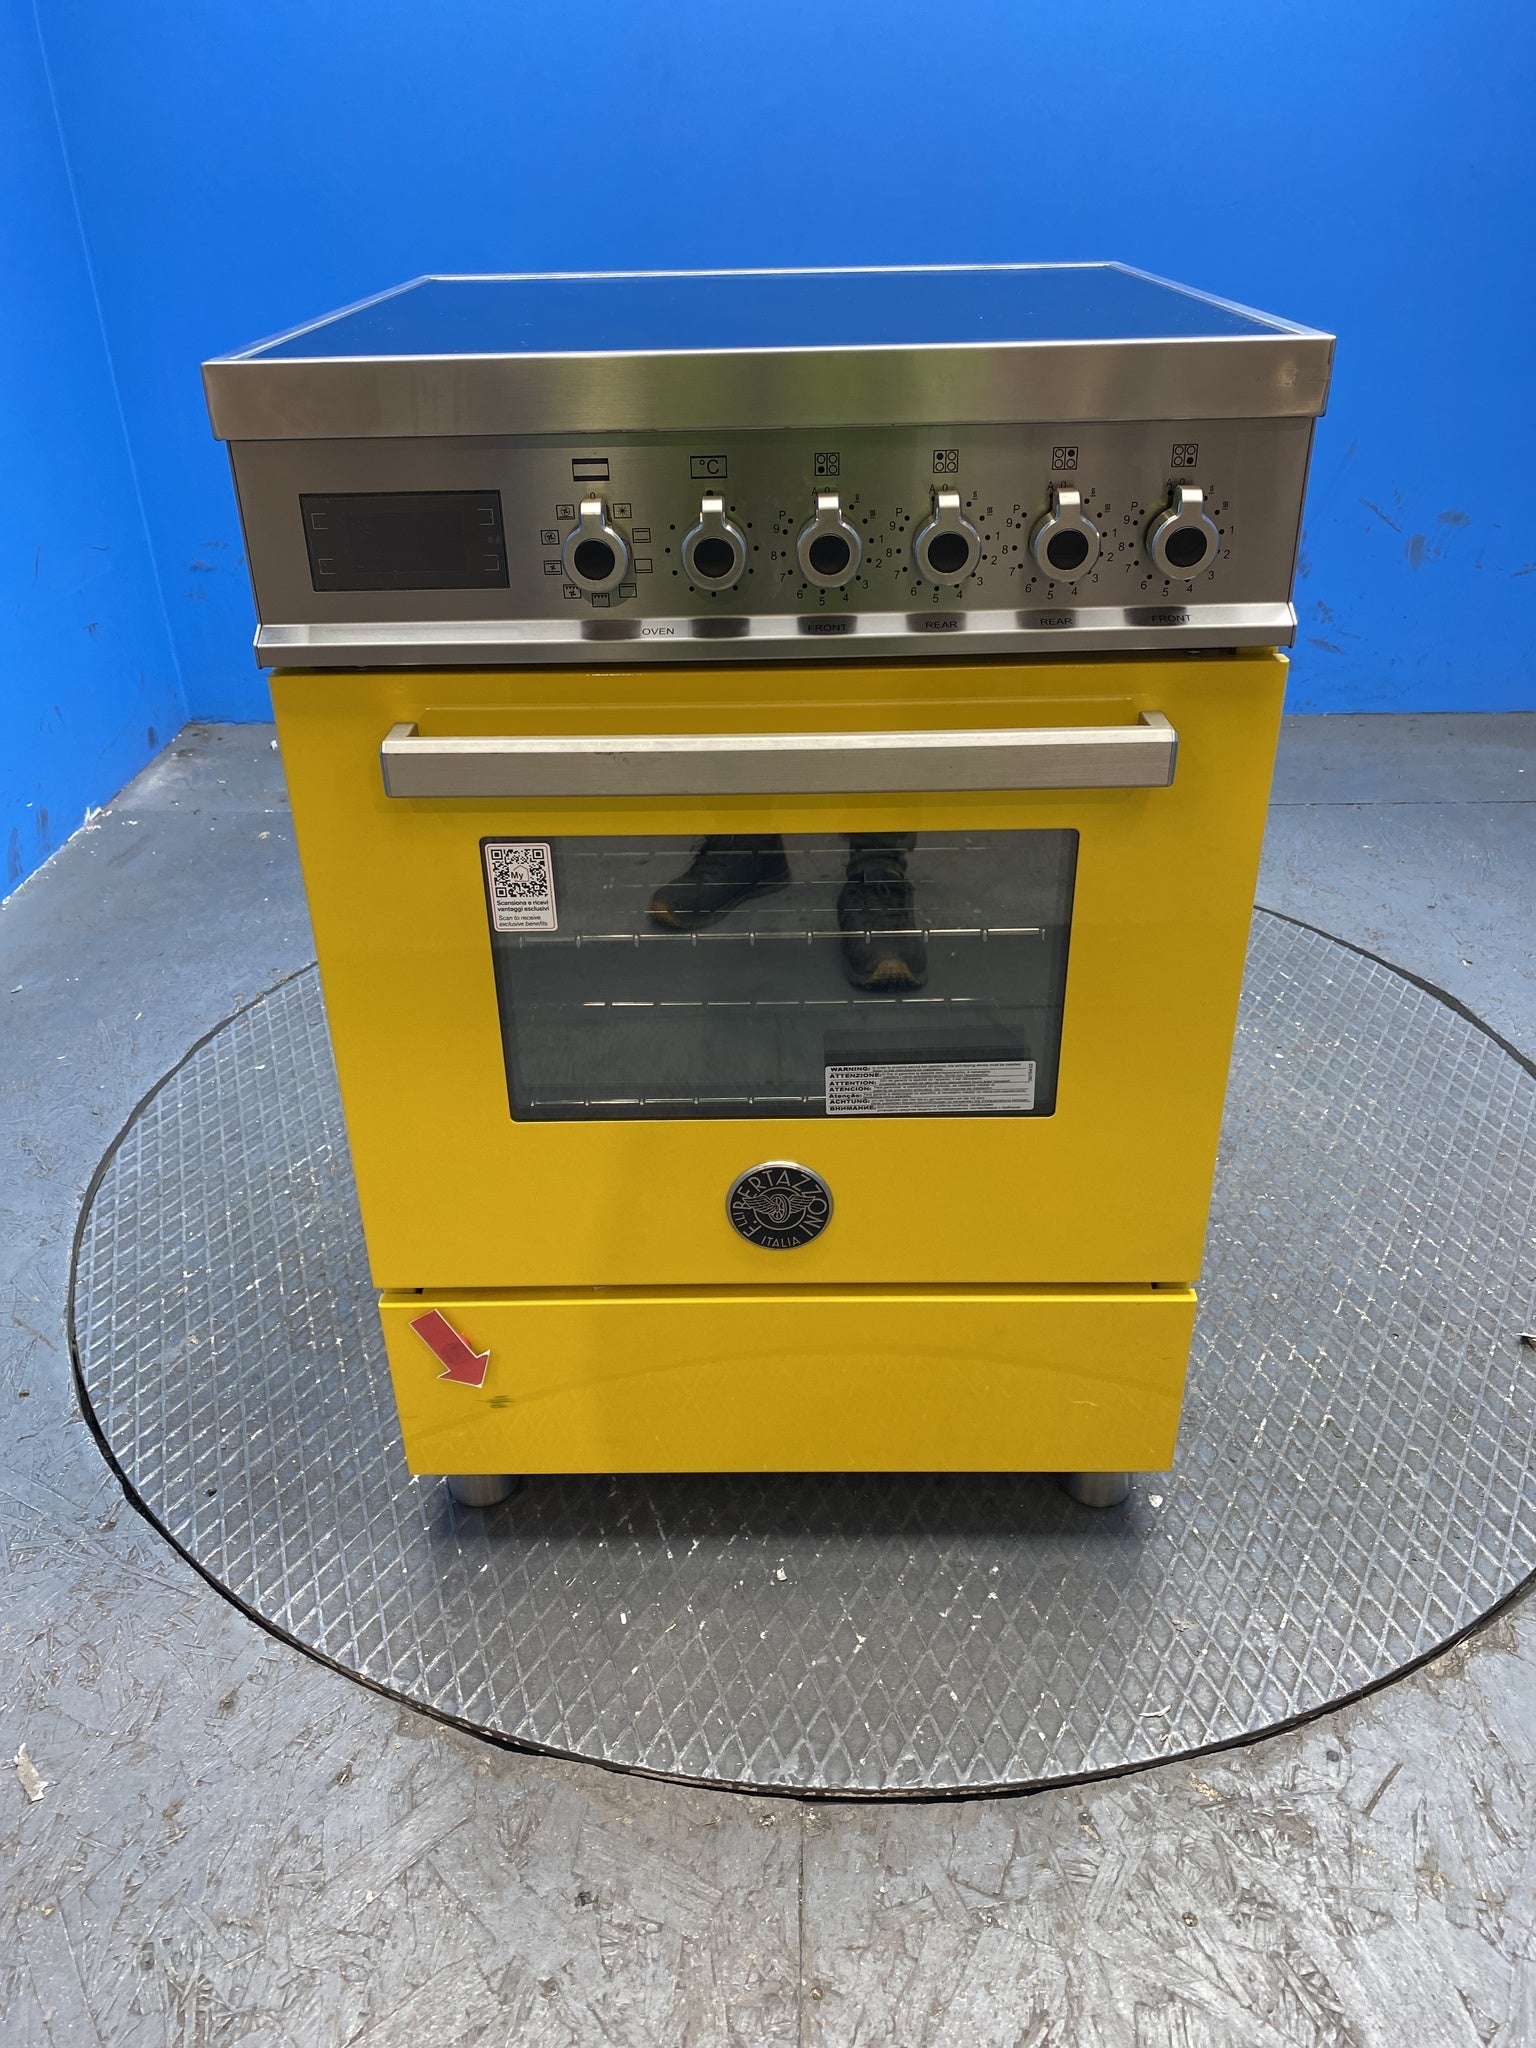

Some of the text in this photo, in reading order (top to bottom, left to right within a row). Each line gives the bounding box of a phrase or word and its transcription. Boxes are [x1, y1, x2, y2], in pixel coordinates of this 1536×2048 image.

[1013, 504, 1021, 514] P
[1131, 502, 1138, 511] P
[779, 510, 786, 520] P
[896, 508, 903, 517] P
[1006, 518, 1013, 527] 9
[1123, 515, 1130, 525] 9
[773, 524, 780, 534] 9
[889, 521, 896, 530] 9
[1001, 545, 1009, 555] 8
[1118, 542, 1125, 552] 8
[771, 551, 778, 561] 8
[886, 548, 893, 558] 8
[1106, 552, 1114, 562] 2
[1223, 550, 1230, 559] 2
[875, 559, 882, 568] 2
[991, 555, 998, 565] 2
[1009, 567, 1015, 576] 7
[1125, 564, 1132, 573] 7
[780, 573, 786, 582] 7
[894, 570, 900, 579] 7
[1092, 573, 1099, 583] 3
[1207, 570, 1215, 580] 3
[862, 580, 869, 589] 3
[976, 577, 983, 586] 3
[1140, 580, 1147, 590] 6
[910, 586, 917, 596] 6
[1025, 583, 1032, 593] 6
[1071, 587, 1078, 596] 4
[1162, 587, 1169, 597] 5
[1186, 584, 1193, 593] 4
[796, 590, 803, 600] 6
[842, 593, 849, 602] 4
[932, 594, 939, 603] 5
[956, 590, 963, 600] 4
[1047, 590, 1054, 600] 5
[819, 597, 826, 606] 5
[1040, 618, 1072, 626] REAR
[1151, 614, 1192, 622] FRONT
[808, 624, 848, 632] FRONT
[926, 621, 958, 629] REAR
[642, 627, 674, 636] OVEN
[510, 872, 524, 880] My
[761, 1236, 800, 1248] ITALIA
